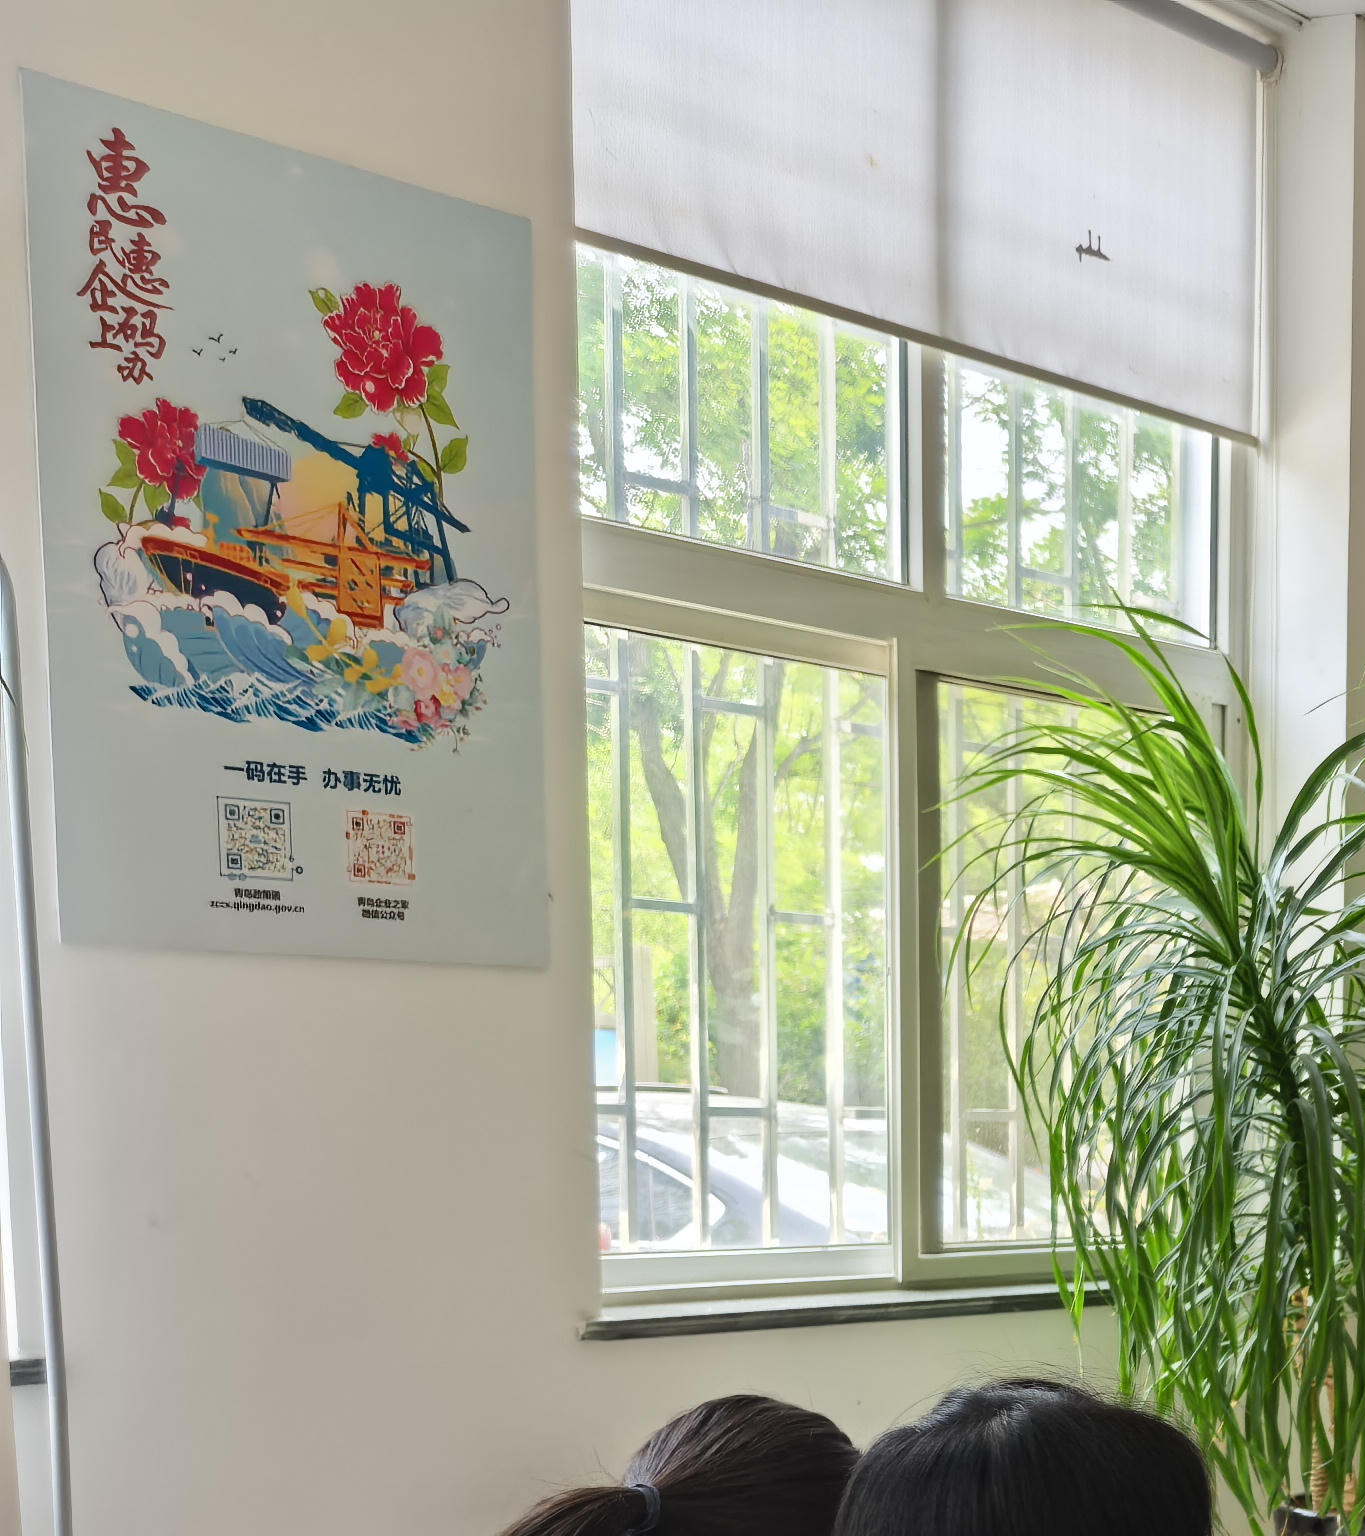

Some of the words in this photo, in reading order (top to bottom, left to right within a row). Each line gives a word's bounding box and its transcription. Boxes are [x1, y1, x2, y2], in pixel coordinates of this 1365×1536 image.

[224, 761, 307, 786] 一码在手
[322, 768, 402, 796] 办事无忧
